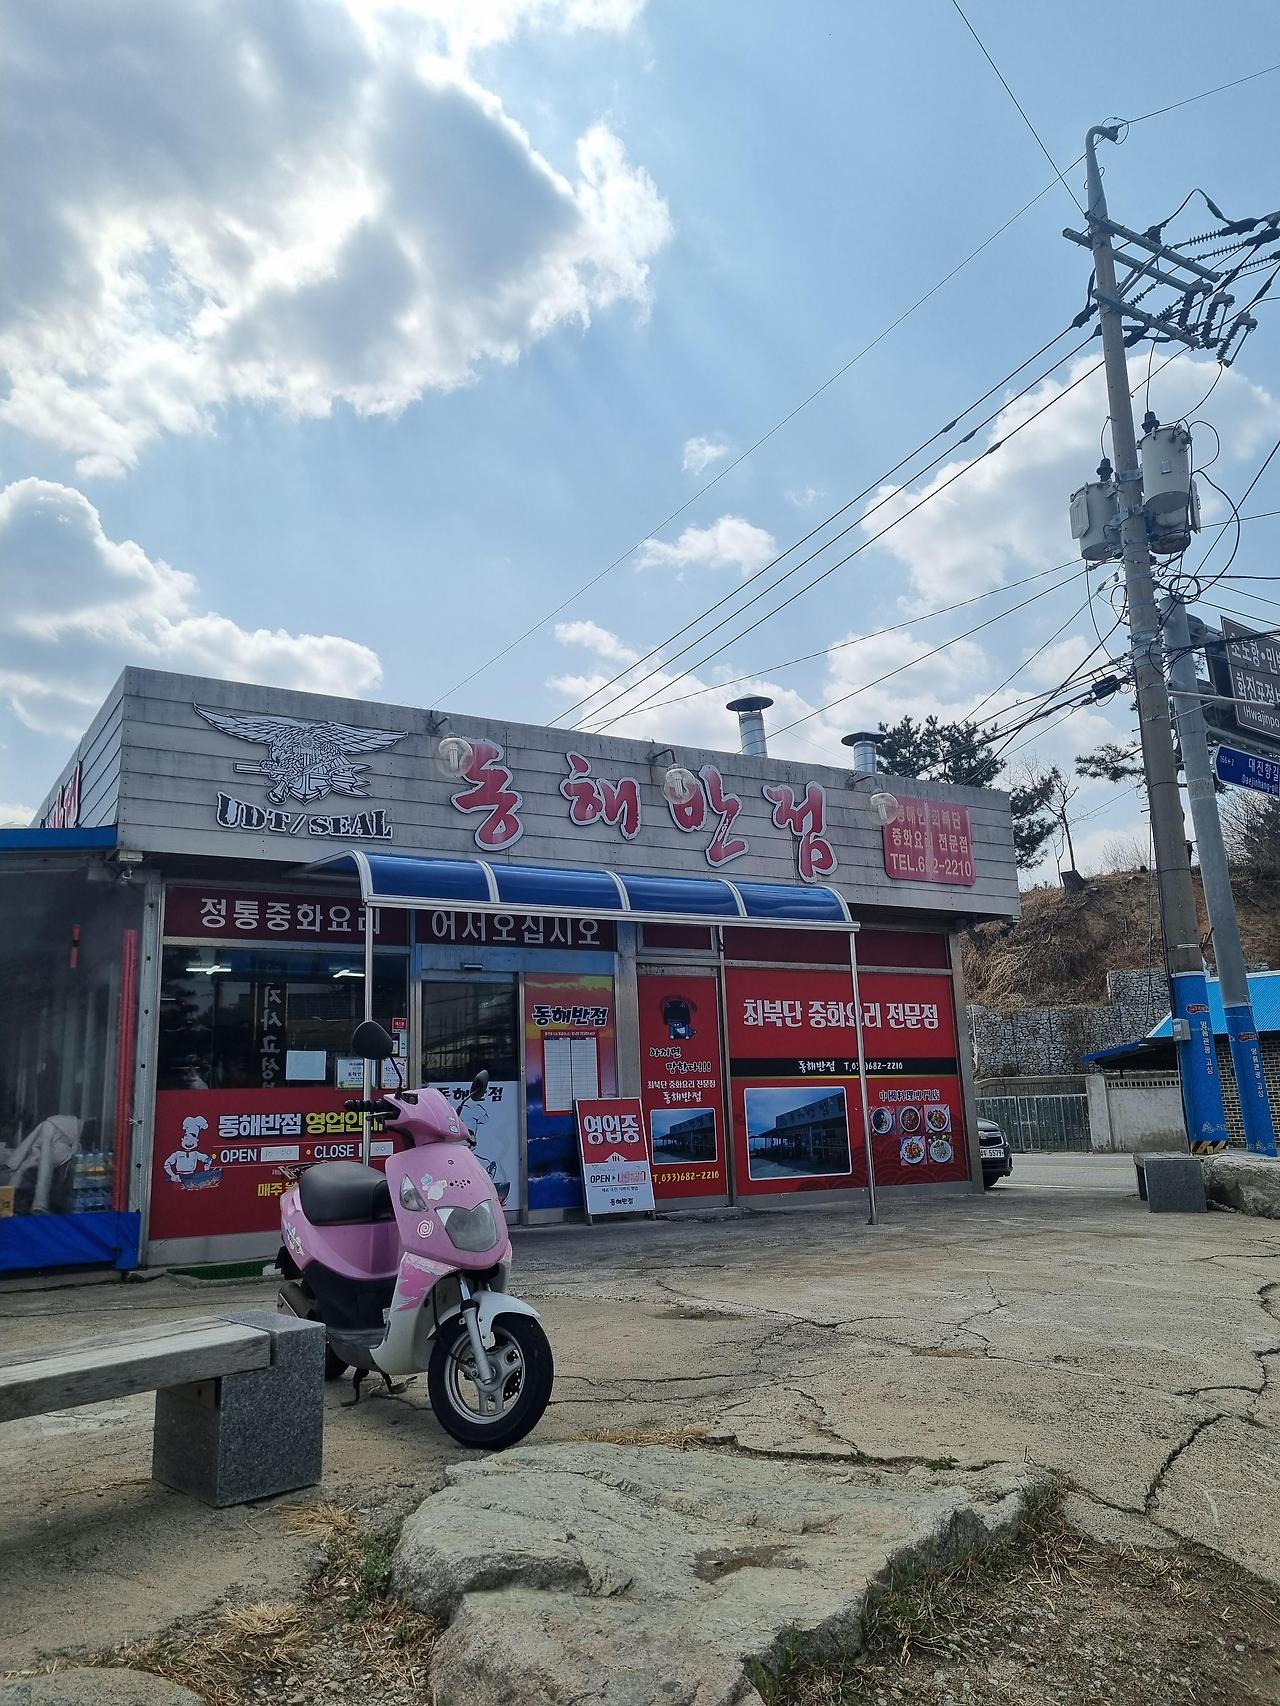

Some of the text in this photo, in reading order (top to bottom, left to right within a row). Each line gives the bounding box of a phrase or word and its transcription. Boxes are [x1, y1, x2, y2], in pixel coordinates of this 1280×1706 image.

[1248, 758, 1279, 782] 대진항길
[217, 791, 393, 839] UDT/SEAL
[450, 738, 838, 884] 동해반점
[938, 833, 968, 854] 전문점
[431, 910, 600, 945] 어서오십시오
[532, 1004, 609, 1027] 동해반점
[743, 999, 939, 1029] 최북단 중화요리 전문점
[649, 1046, 682, 1058] 아끼면
[665, 1060, 711, 1075] 망한다!!!
[798, 1060, 903, 1074] 동해반점 T.03)682-2210
[647, 1080, 716, 1089] 최북단 중화요리 전문점
[663, 1091, 702, 1105] 동해반점
[218, 1113, 301, 1138] 동해반점
[583, 1115, 640, 1145] 영업중
[220, 1148, 257, 1163] OPEN
[314, 1145, 355, 1159] CLOSE
[590, 1174, 611, 1183] OPEN
[652, 1170, 720, 1185] T.033)682-2210
[257, 1183, 283, 1197] 매주
